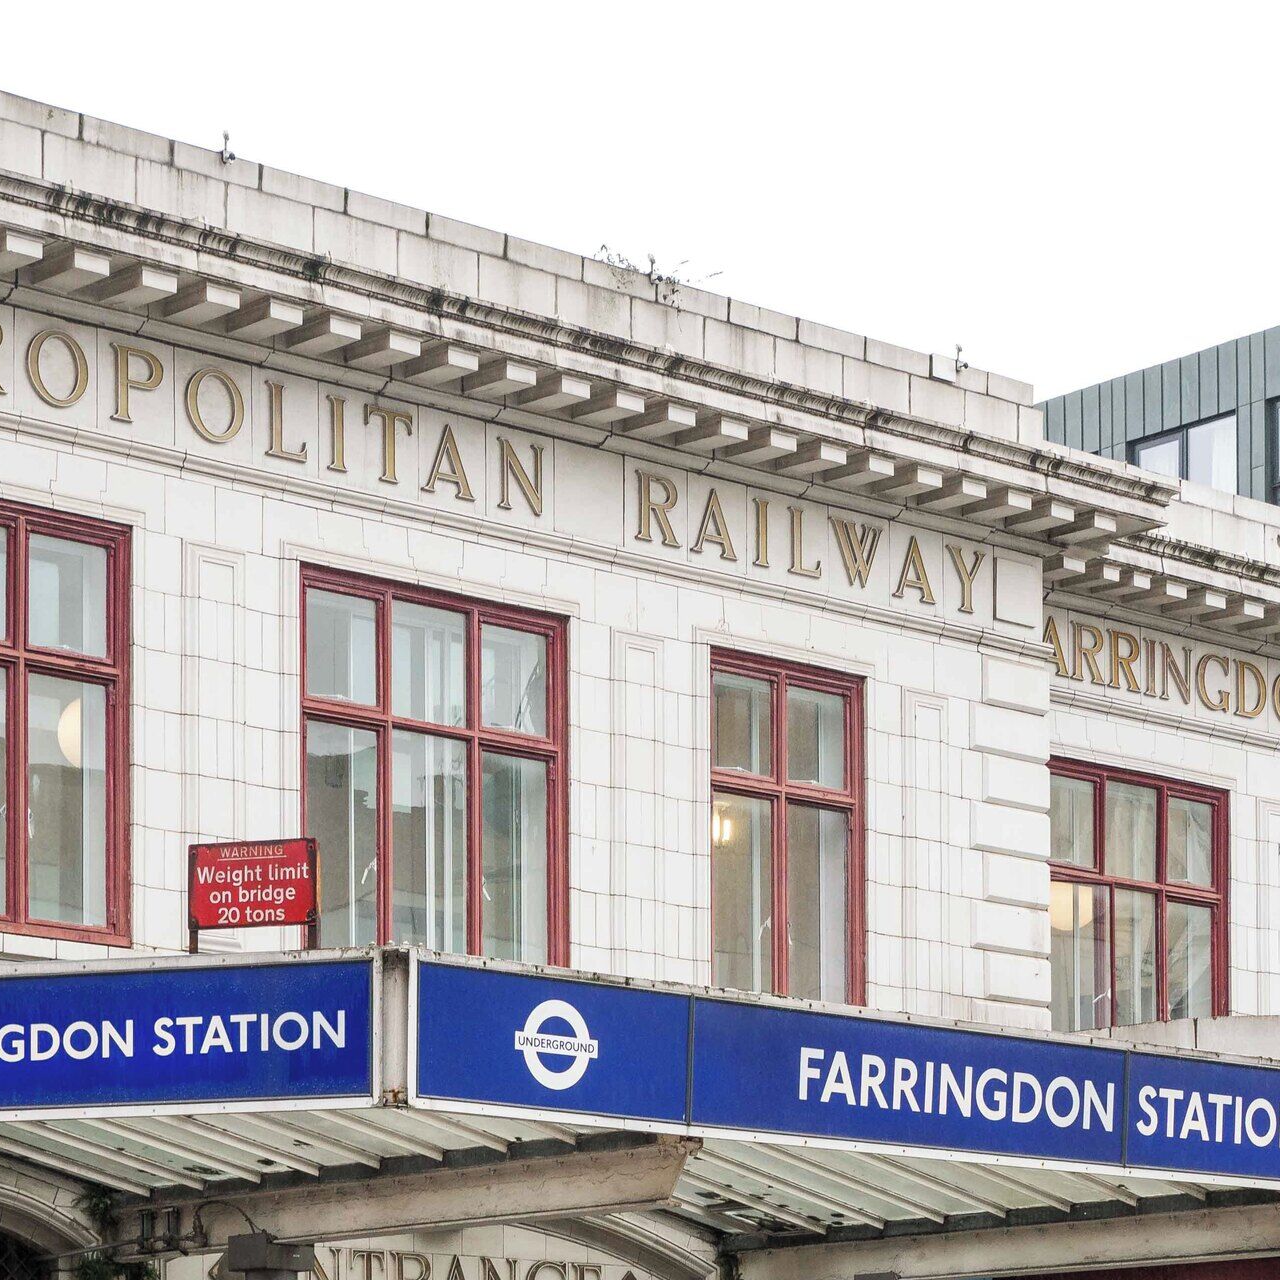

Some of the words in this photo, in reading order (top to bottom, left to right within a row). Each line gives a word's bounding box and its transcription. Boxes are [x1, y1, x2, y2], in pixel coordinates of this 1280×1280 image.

[634, 469, 986, 614] RAILWAY
[220, 845, 284, 857] WARNING
[197, 865, 262, 885] Weight
[269, 863, 309, 880] limit
[210, 890, 231, 903] on
[238, 885, 296, 904] bridge
[218, 907, 240, 923] 20
[245, 906, 285, 921] tons
[152, 1010, 346, 1057] STATION
[518, 1036, 594, 1053] UNDERGROUND
[798, 1047, 1114, 1131] FARRINGDON
